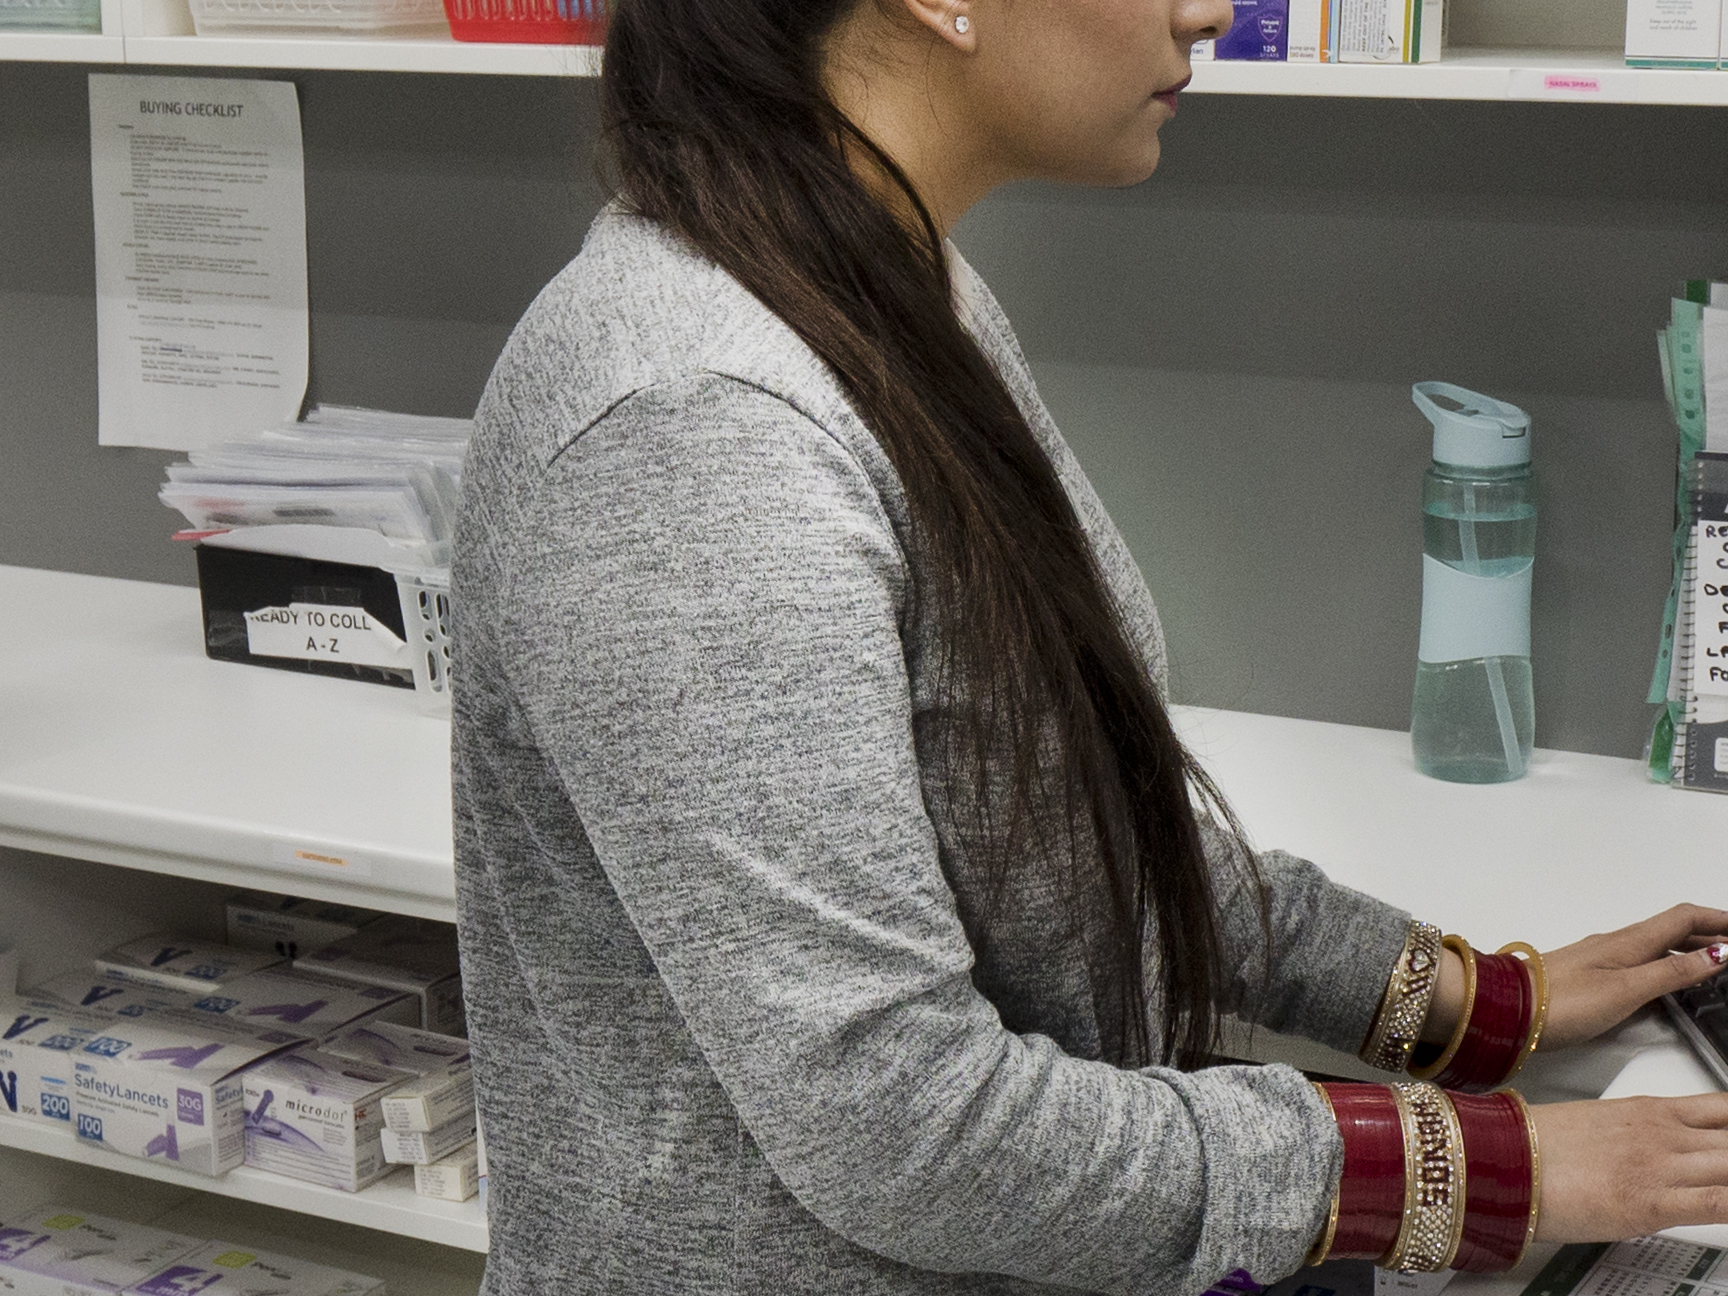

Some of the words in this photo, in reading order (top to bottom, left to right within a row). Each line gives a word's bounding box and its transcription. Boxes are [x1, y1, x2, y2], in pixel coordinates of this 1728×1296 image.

[140, 100, 182, 115] BUYING
[185, 102, 244, 118] CHECKLIST
[307, 612, 325, 627] TO
[330, 613, 372, 630] COLL
[306, 636, 318, 651] A
[329, 638, 340, 653] Z
[74, 1073, 170, 1110] SafetyLancets
[42, 1095, 69, 1115] 200
[177, 1093, 203, 1112] 30G
[284, 1098, 346, 1122] microdot
[79, 1115, 102, 1136] 100
